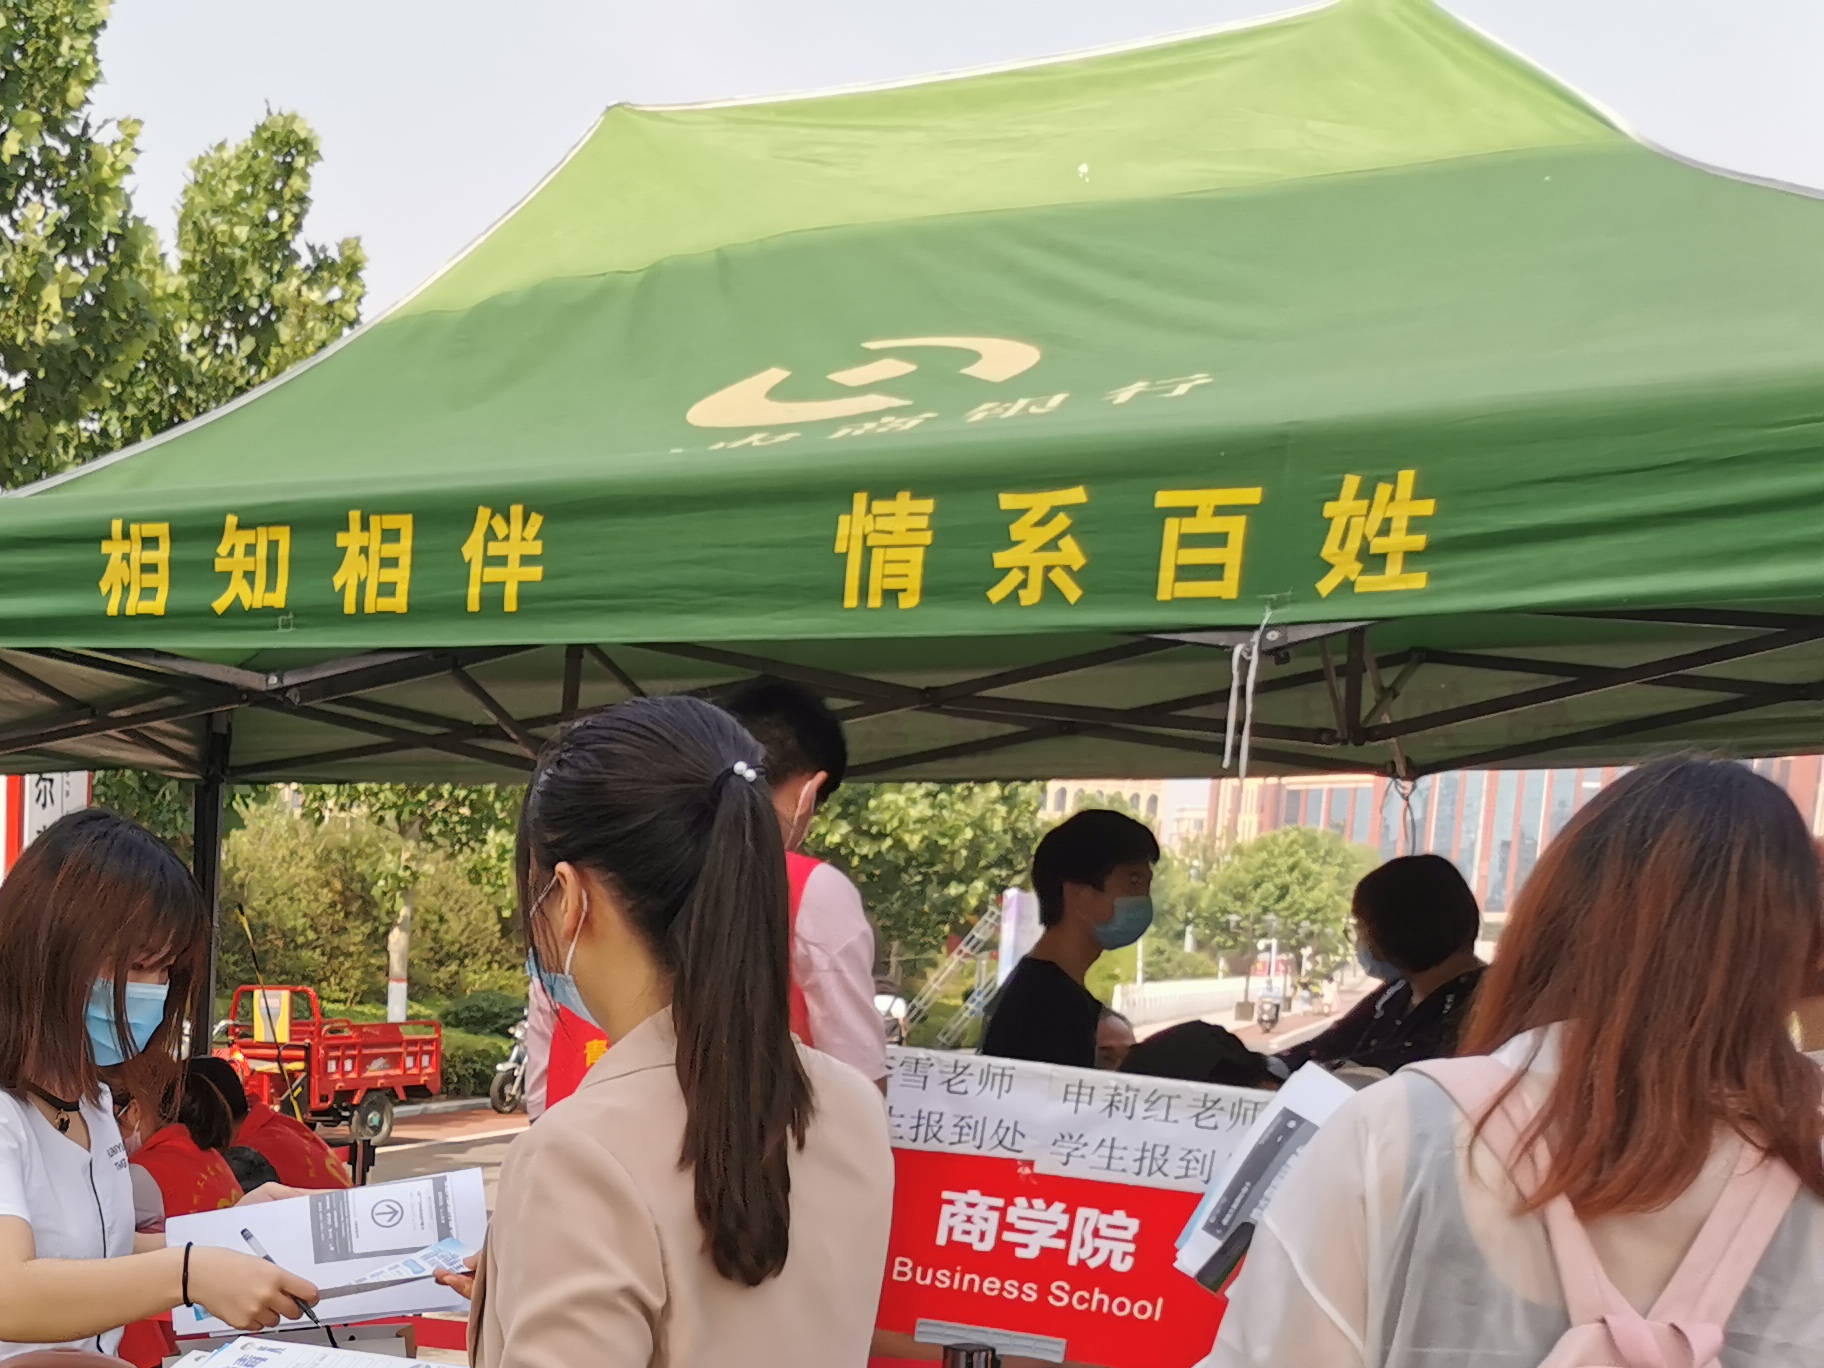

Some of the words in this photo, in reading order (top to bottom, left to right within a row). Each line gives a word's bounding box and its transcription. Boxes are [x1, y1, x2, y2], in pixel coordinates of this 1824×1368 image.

[99, 505, 543, 615] 相知相伴
[835, 470, 1436, 609] 情系百姓
[1050, 1130, 1234, 1186] 学生报到
[934, 1189, 1140, 1274] 商学院
[891, 1257, 1038, 1302] Business
[1047, 1279, 1164, 1321] School
